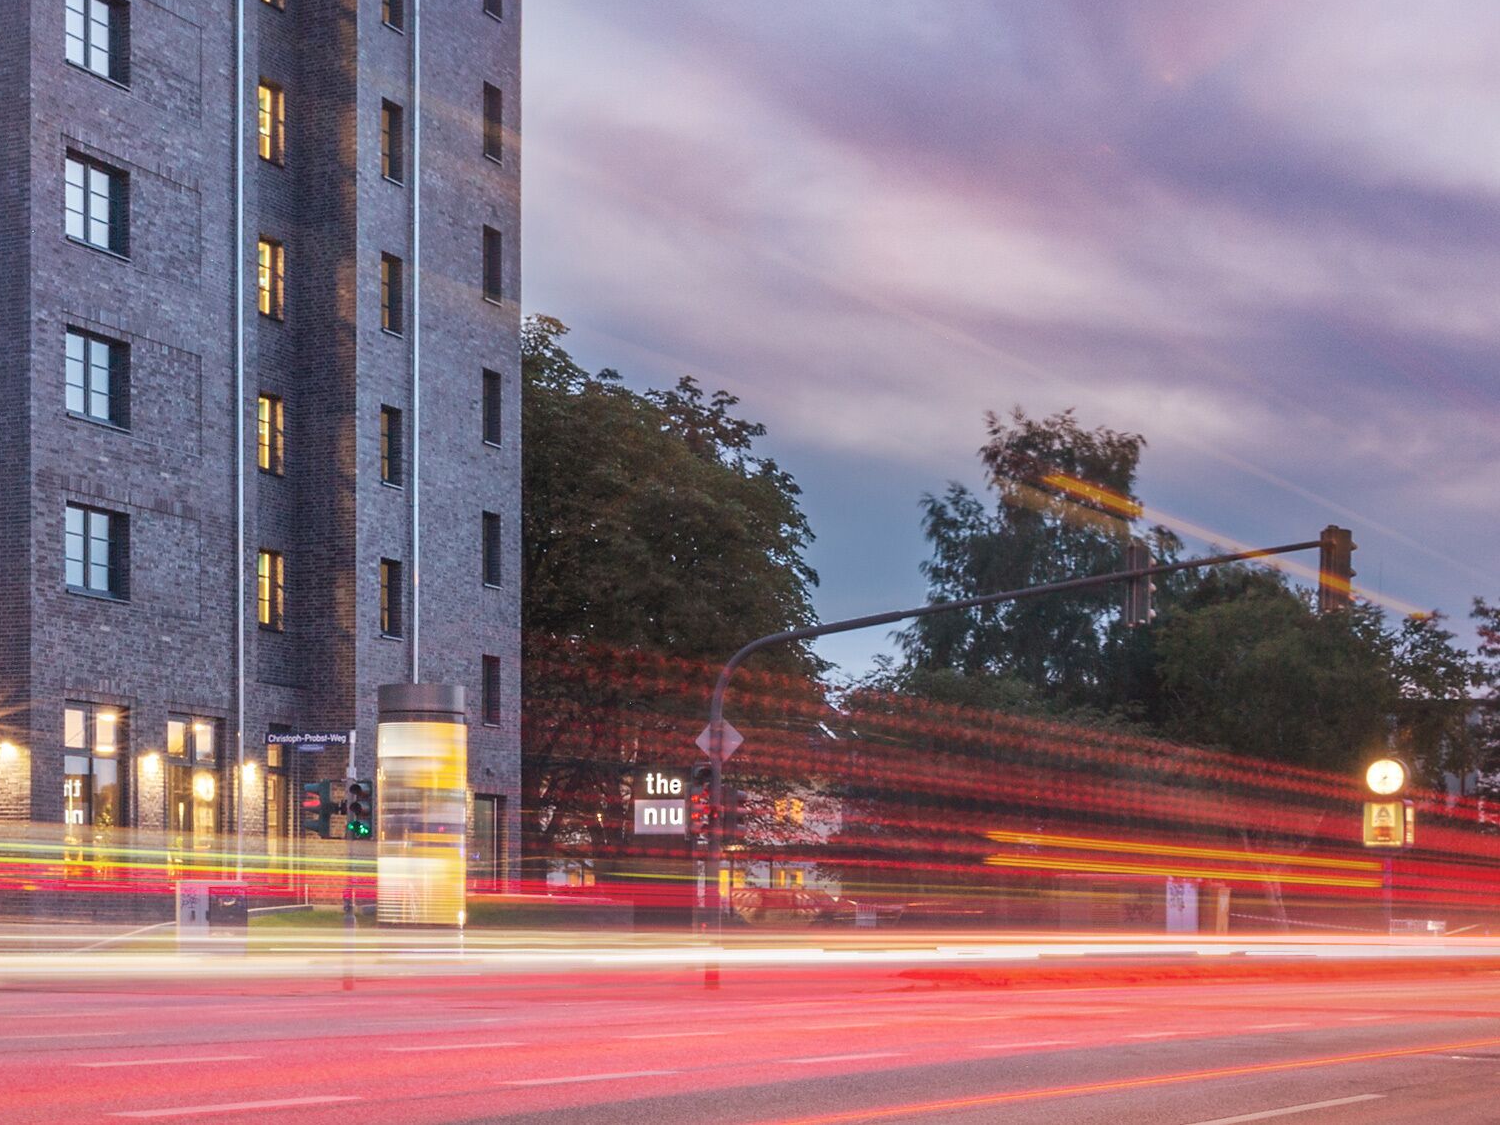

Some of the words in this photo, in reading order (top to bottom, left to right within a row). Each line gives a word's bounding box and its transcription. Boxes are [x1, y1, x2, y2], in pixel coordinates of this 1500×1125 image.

[267, 733, 347, 744] Christoph-Probst-Weg
[645, 772, 682, 795] the
[643, 807, 683, 826] niu
